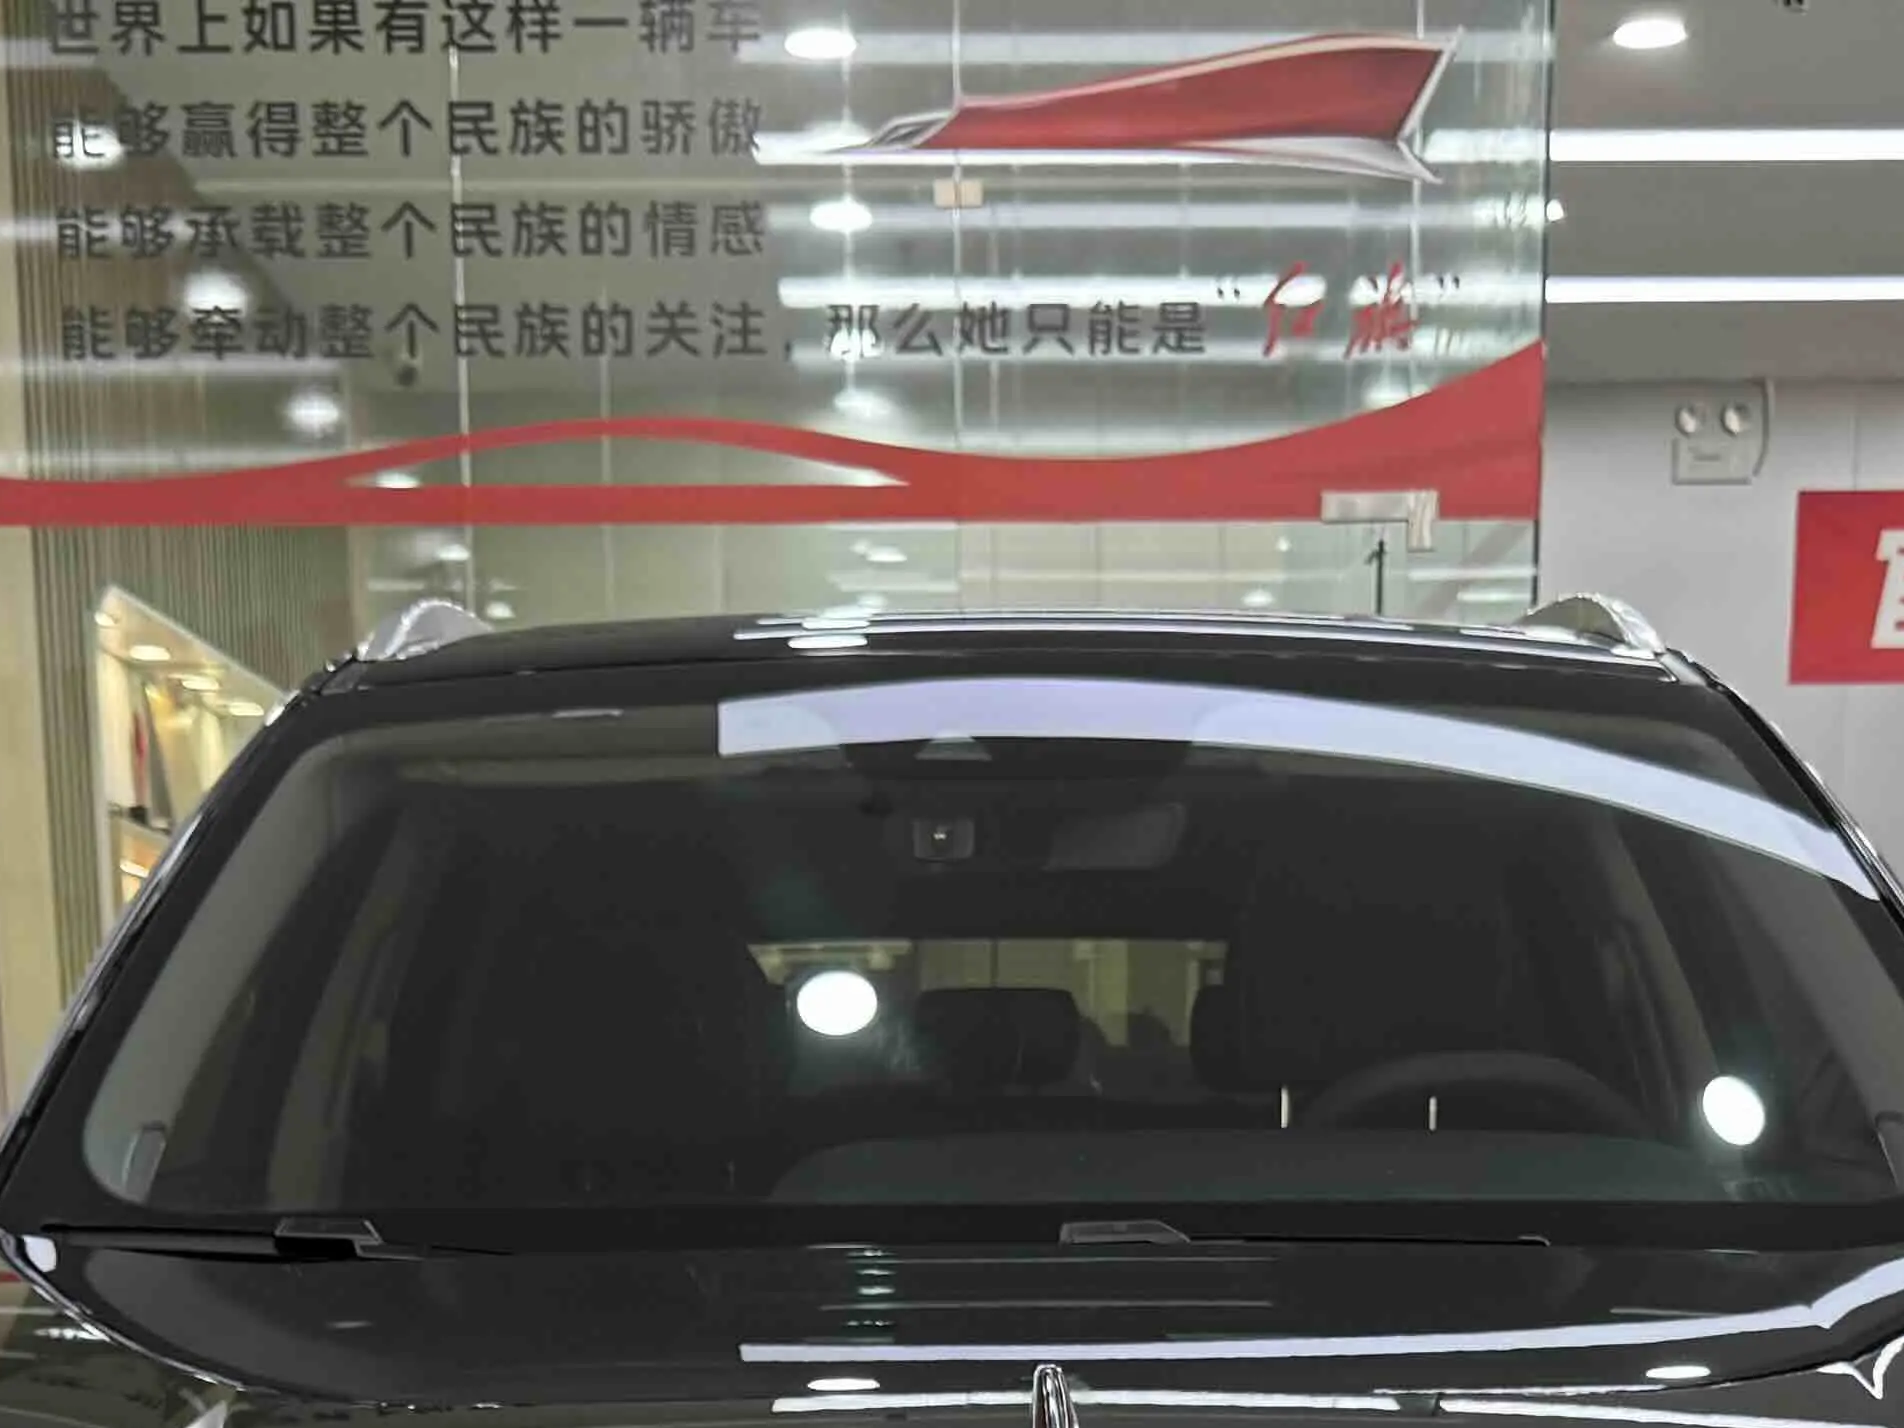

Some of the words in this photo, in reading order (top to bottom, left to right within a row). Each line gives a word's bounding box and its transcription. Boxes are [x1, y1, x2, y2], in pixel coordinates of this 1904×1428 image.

[50, 0, 760, 55] 世界上如果有这样一辆车
[52, 98, 761, 159] 能够赢得整个民族的骄傲
[56, 201, 765, 259] 能够承载整个民族的情感
